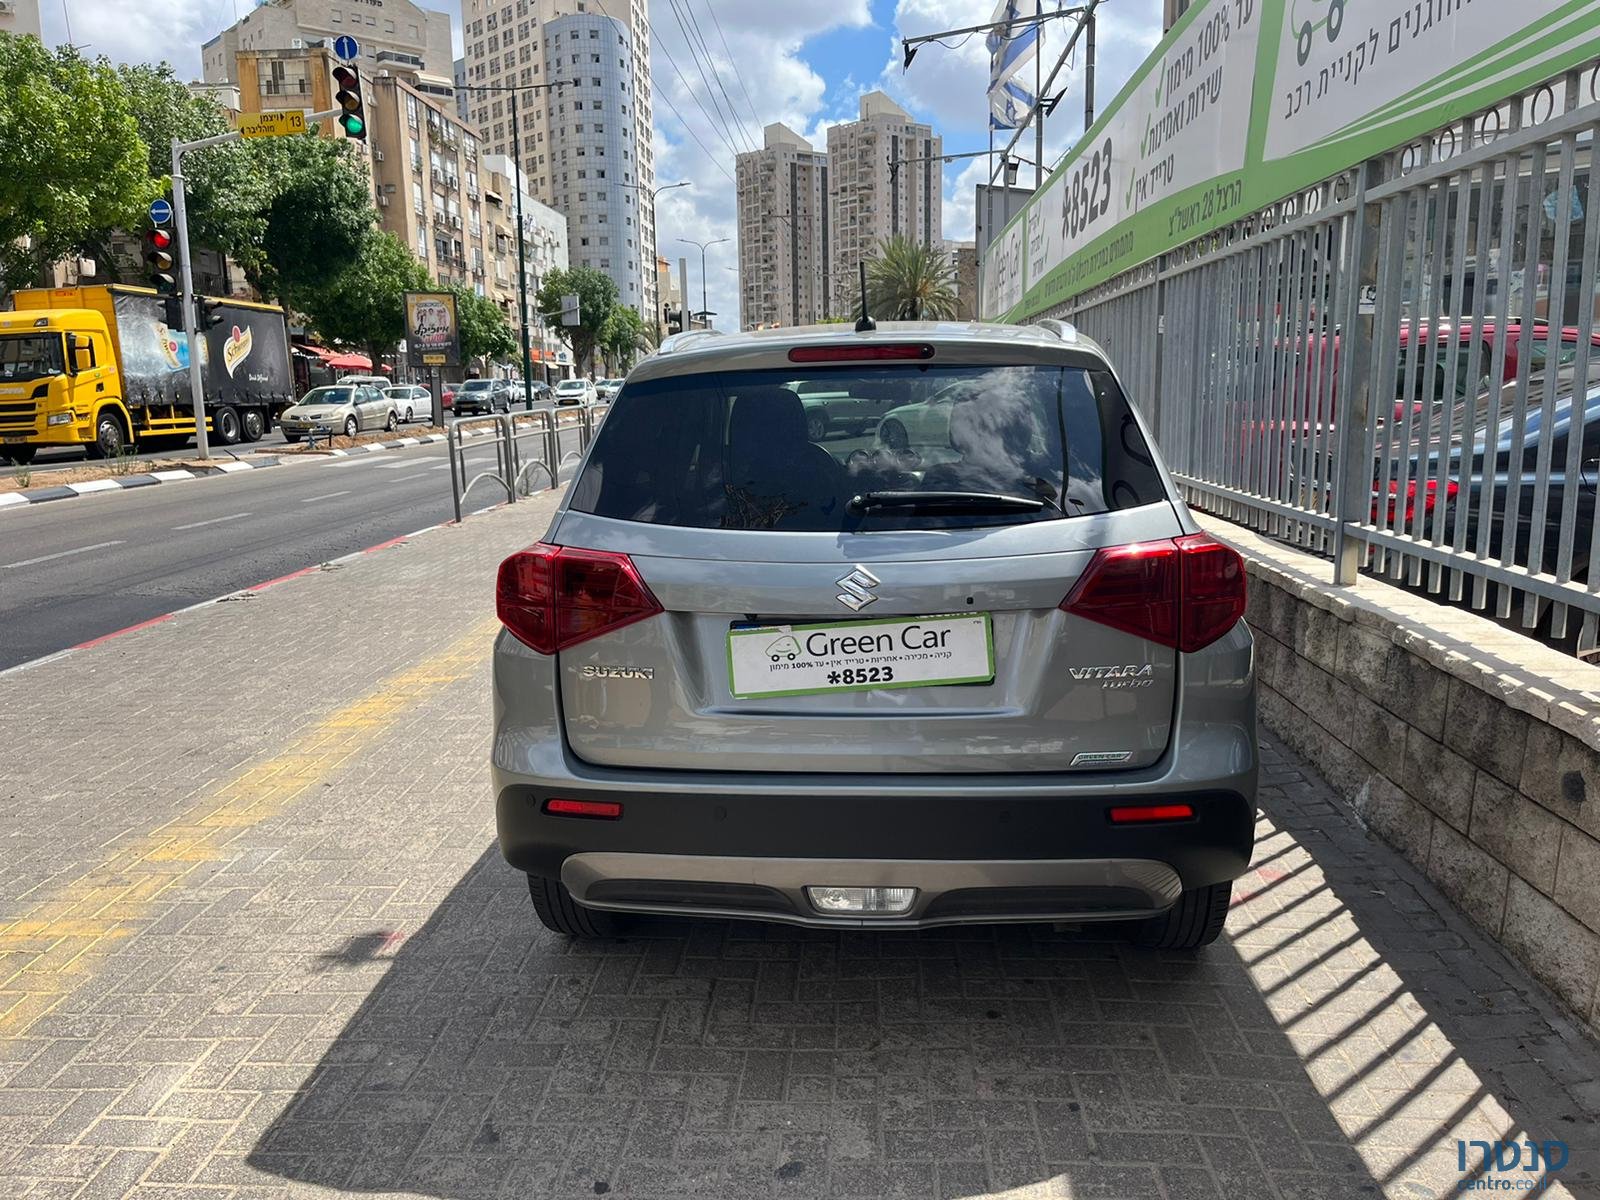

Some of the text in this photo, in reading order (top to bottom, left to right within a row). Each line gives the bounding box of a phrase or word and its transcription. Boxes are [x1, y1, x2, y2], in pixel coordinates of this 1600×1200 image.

[1198, 4, 1230, 67] 100%
[1317, 28, 1379, 99] לקניית
[1166, 46, 1193, 107] מימון
[1285, 80, 1311, 120] רכב
[1148, 65, 1222, 157] שירות ואמינות
[290, 116, 301, 127] 13
[1135, 153, 1174, 214] טרייד אין
[1216, 179, 1242, 214] הרצל
[1202, 189, 1214, 221] 28
[806, 625, 951, 657] Green Car
[831, 659, 842, 667] אין
[845, 657, 864, 665] טרייד
[871, 655, 897, 664] אחריות
[904, 653, 928, 661] מכירה
[934, 651, 952, 660] קניה
[583, 665, 655, 680] SUZUKI
[769, 663, 789, 672] מימון
[792, 661, 813, 669] 100%
[1069, 664, 1153, 679] VITARA
